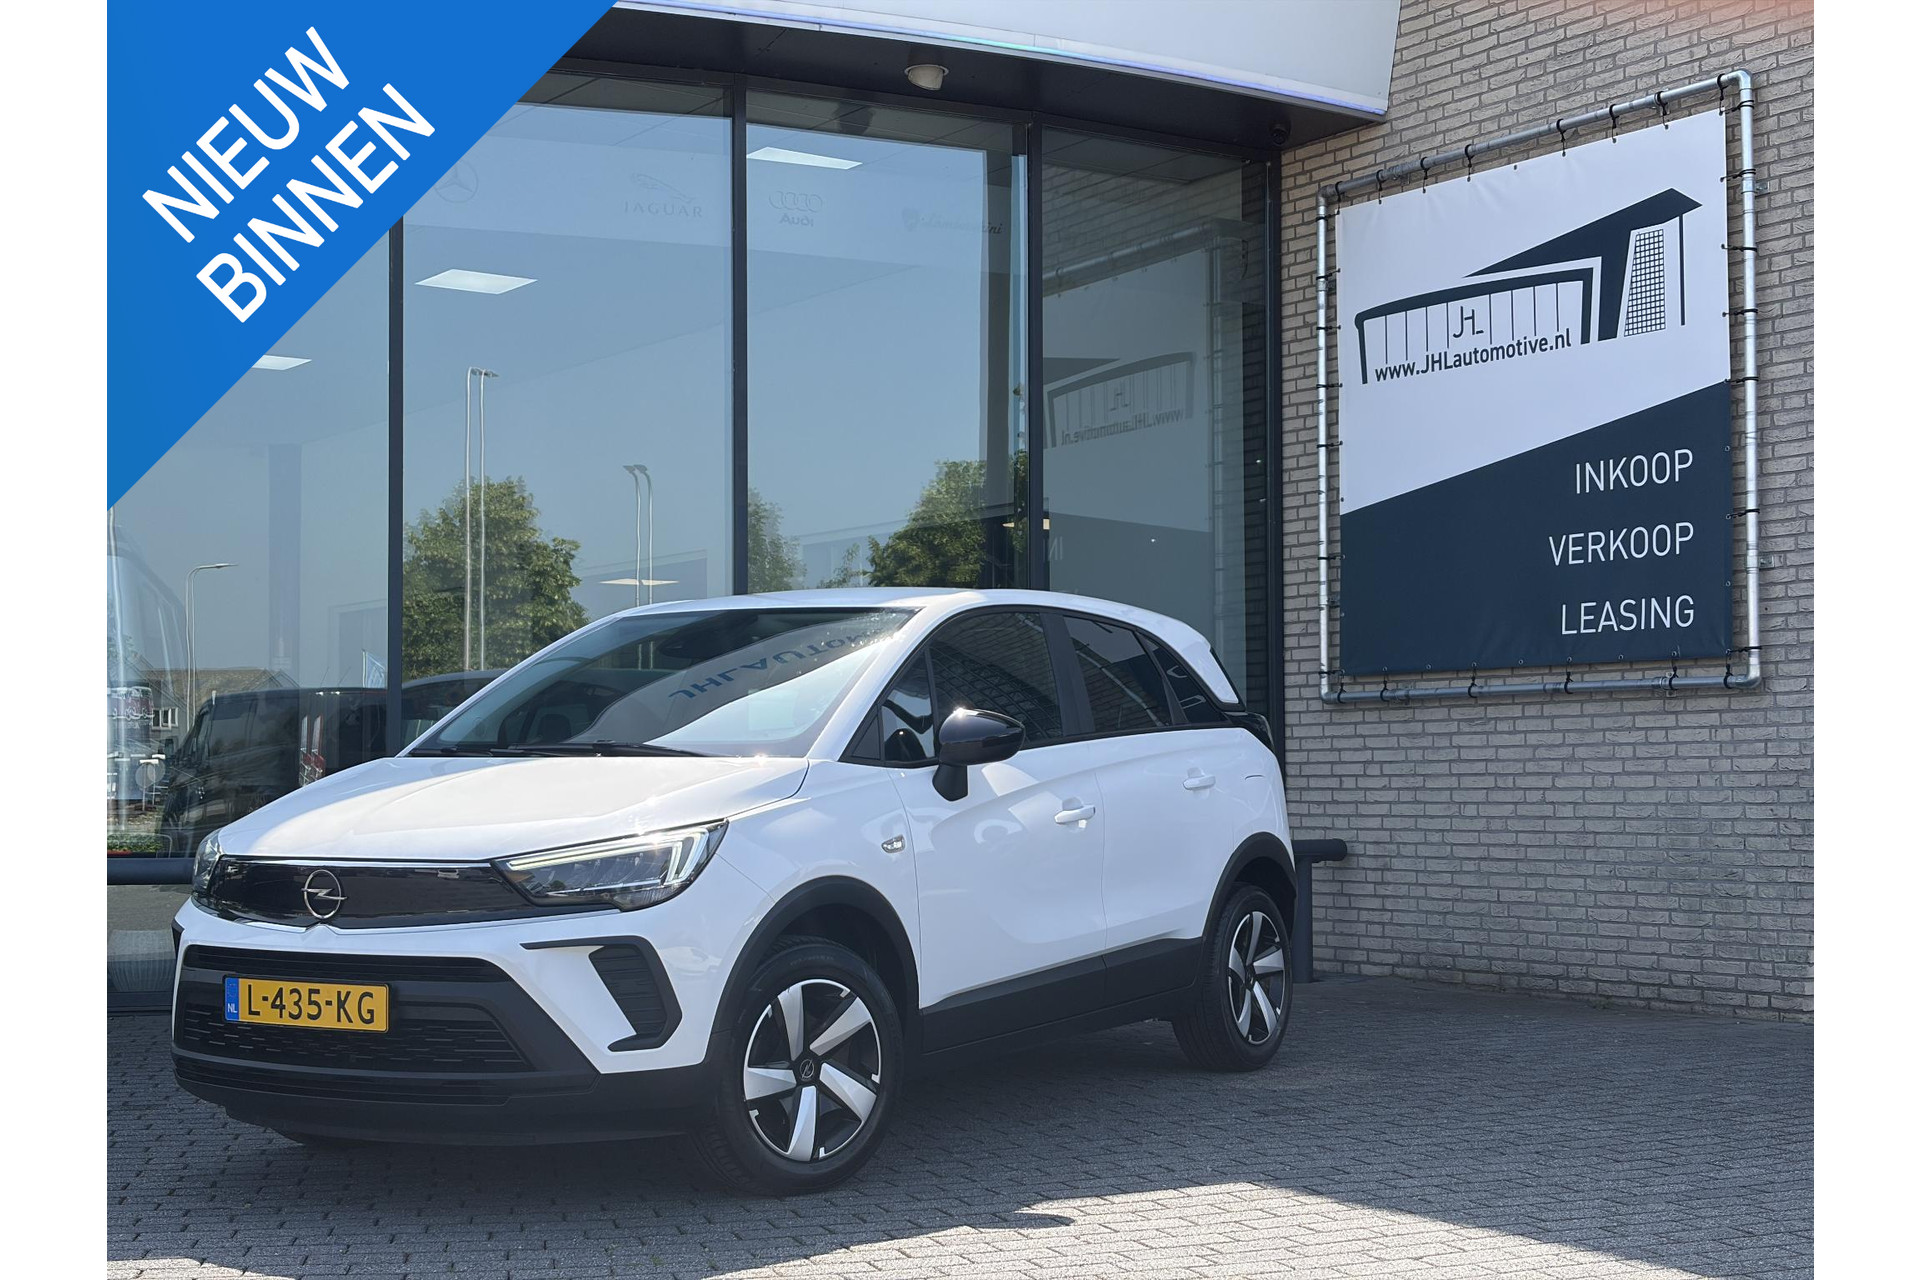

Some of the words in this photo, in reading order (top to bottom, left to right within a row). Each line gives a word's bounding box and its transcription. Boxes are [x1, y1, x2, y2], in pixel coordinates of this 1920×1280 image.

[624, 201, 703, 218] JAGUAR
[779, 213, 814, 228] Audi
[1453, 306, 1485, 339] JHL
[1374, 328, 1572, 382] www.JHLautomotive.nl
[1576, 449, 1693, 494] INKOOP
[1549, 522, 1694, 566] VERKOOP
[1561, 595, 1694, 635] LEASING
[227, 1003, 238, 1014] NL
[248, 984, 375, 1025] L-435-KG
